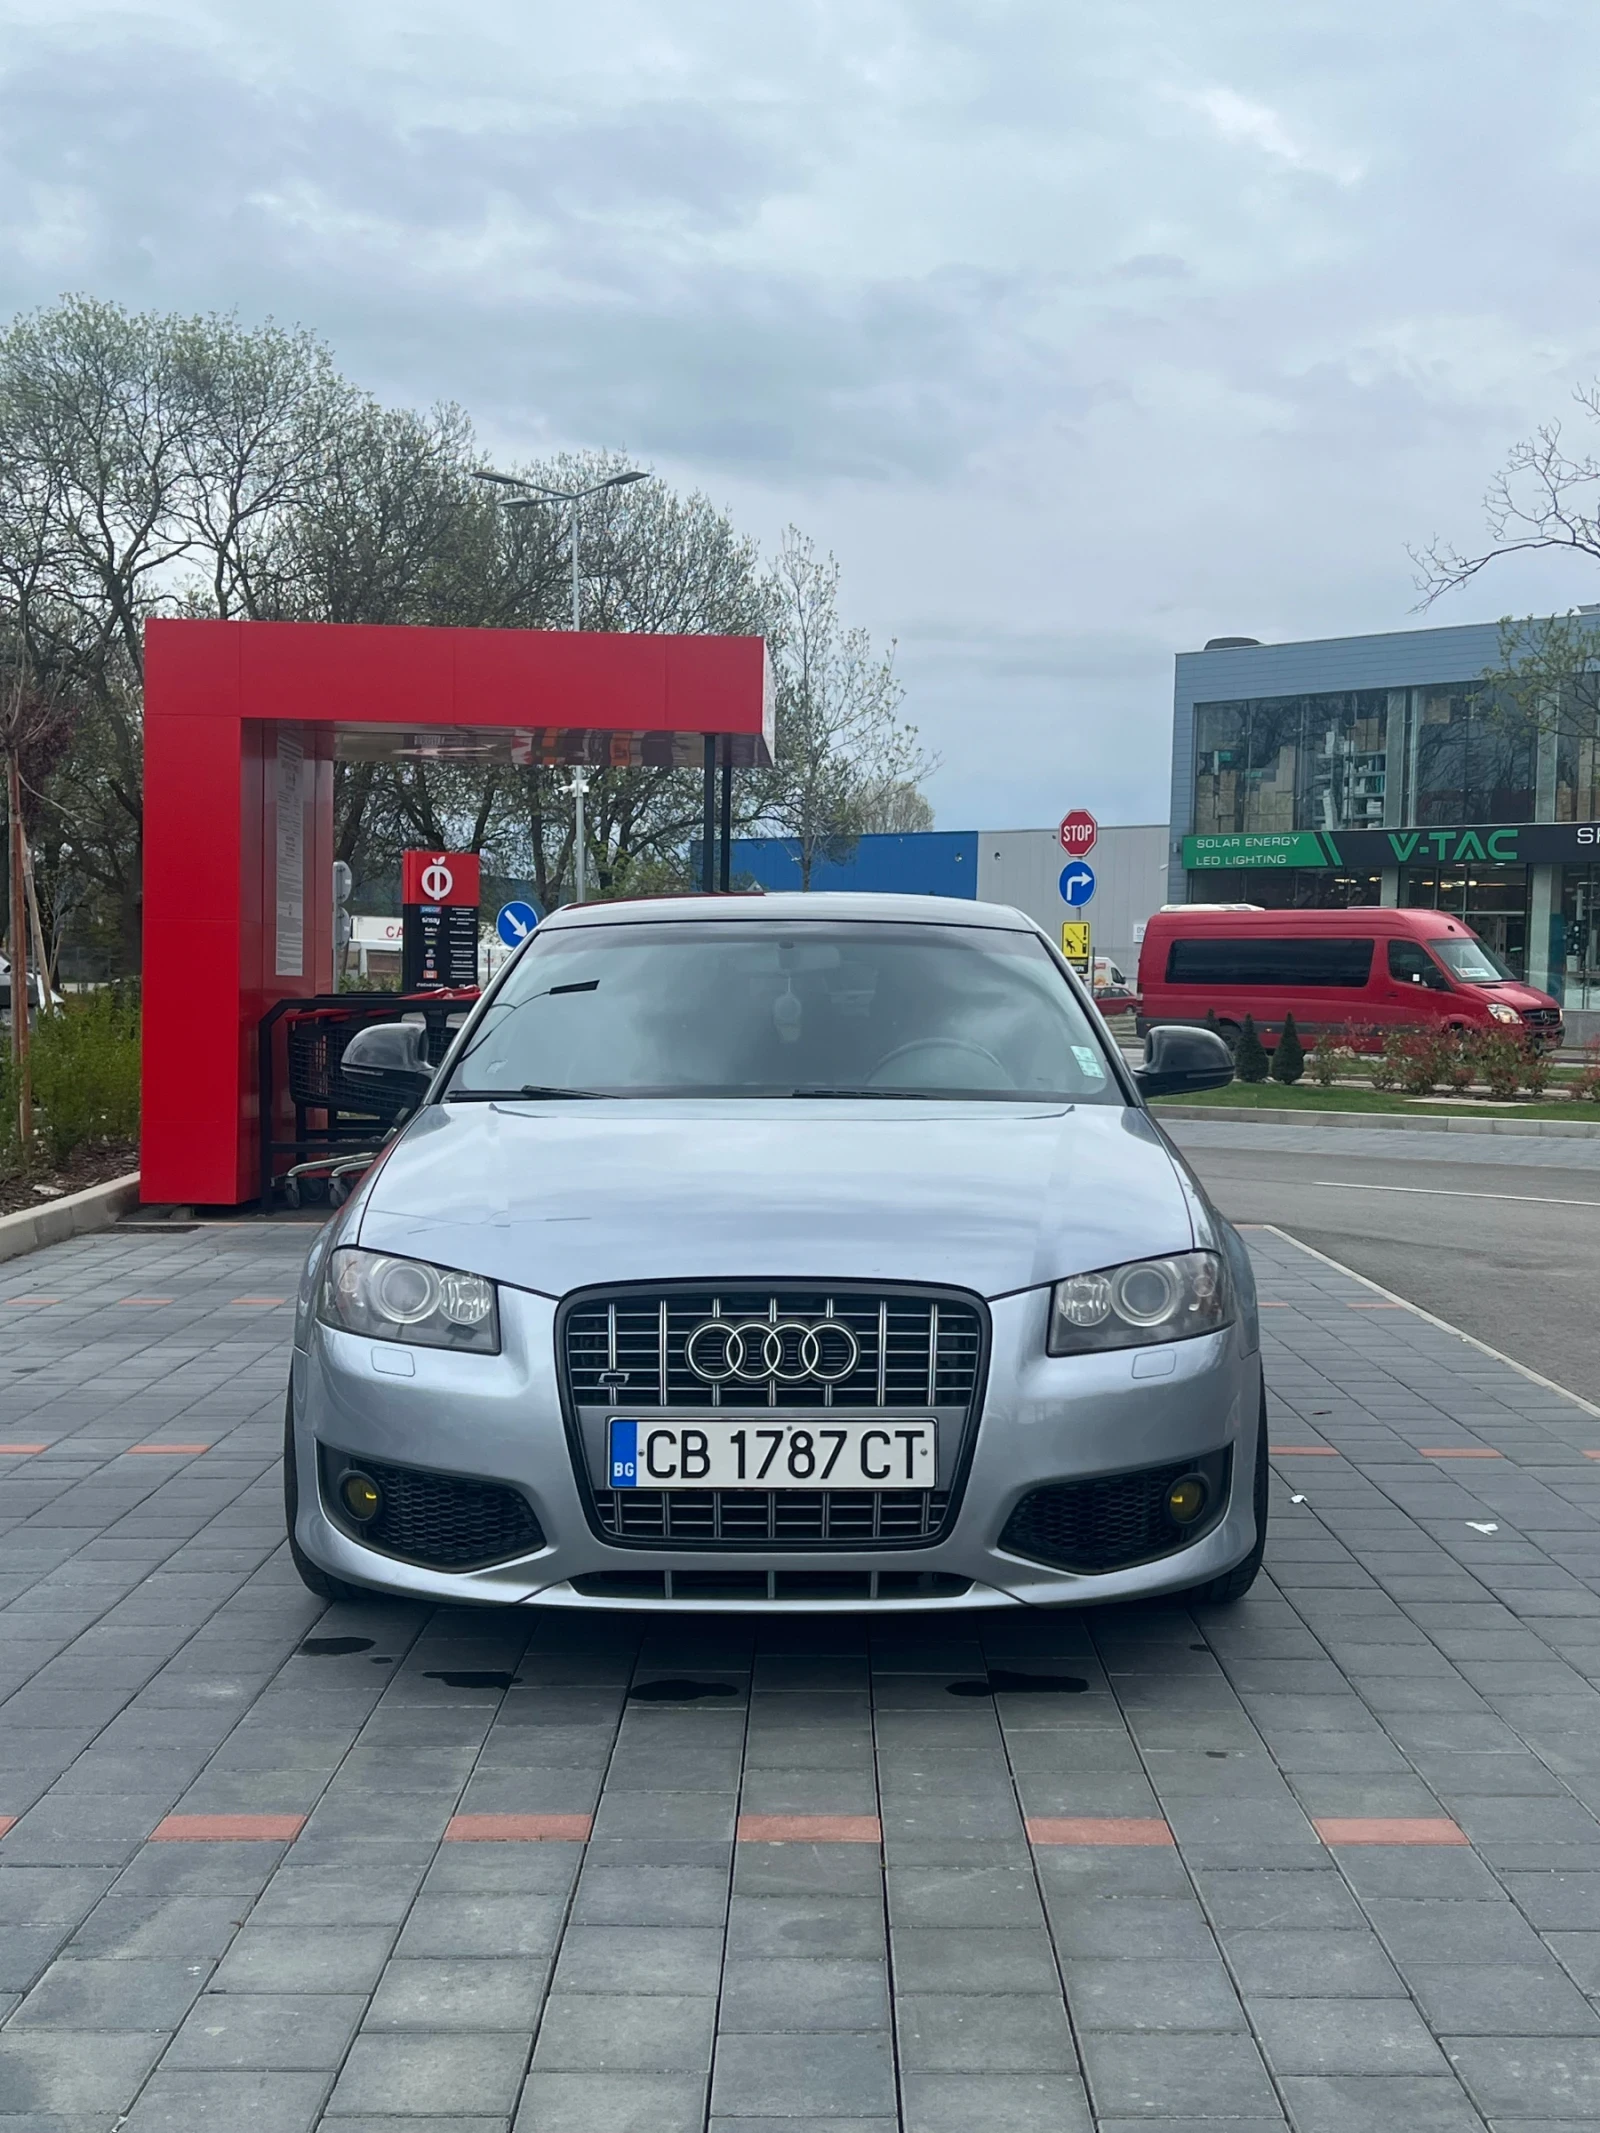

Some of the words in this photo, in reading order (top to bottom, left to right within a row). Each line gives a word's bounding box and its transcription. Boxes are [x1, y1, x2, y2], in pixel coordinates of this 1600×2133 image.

[1063, 824, 1093, 842] STOP
[1196, 838, 1240, 849] SOLAR
[1245, 836, 1300, 847] ENERGY
[1387, 829, 1519, 862] V-TAC
[1195, 855, 1221, 866] LED
[1225, 854, 1287, 865] LIGHTING
[646, 1429, 711, 1479] CB
[730, 1429, 848, 1479] 1787
[860, 1429, 925, 1479] CT
[613, 1462, 635, 1477] BG
